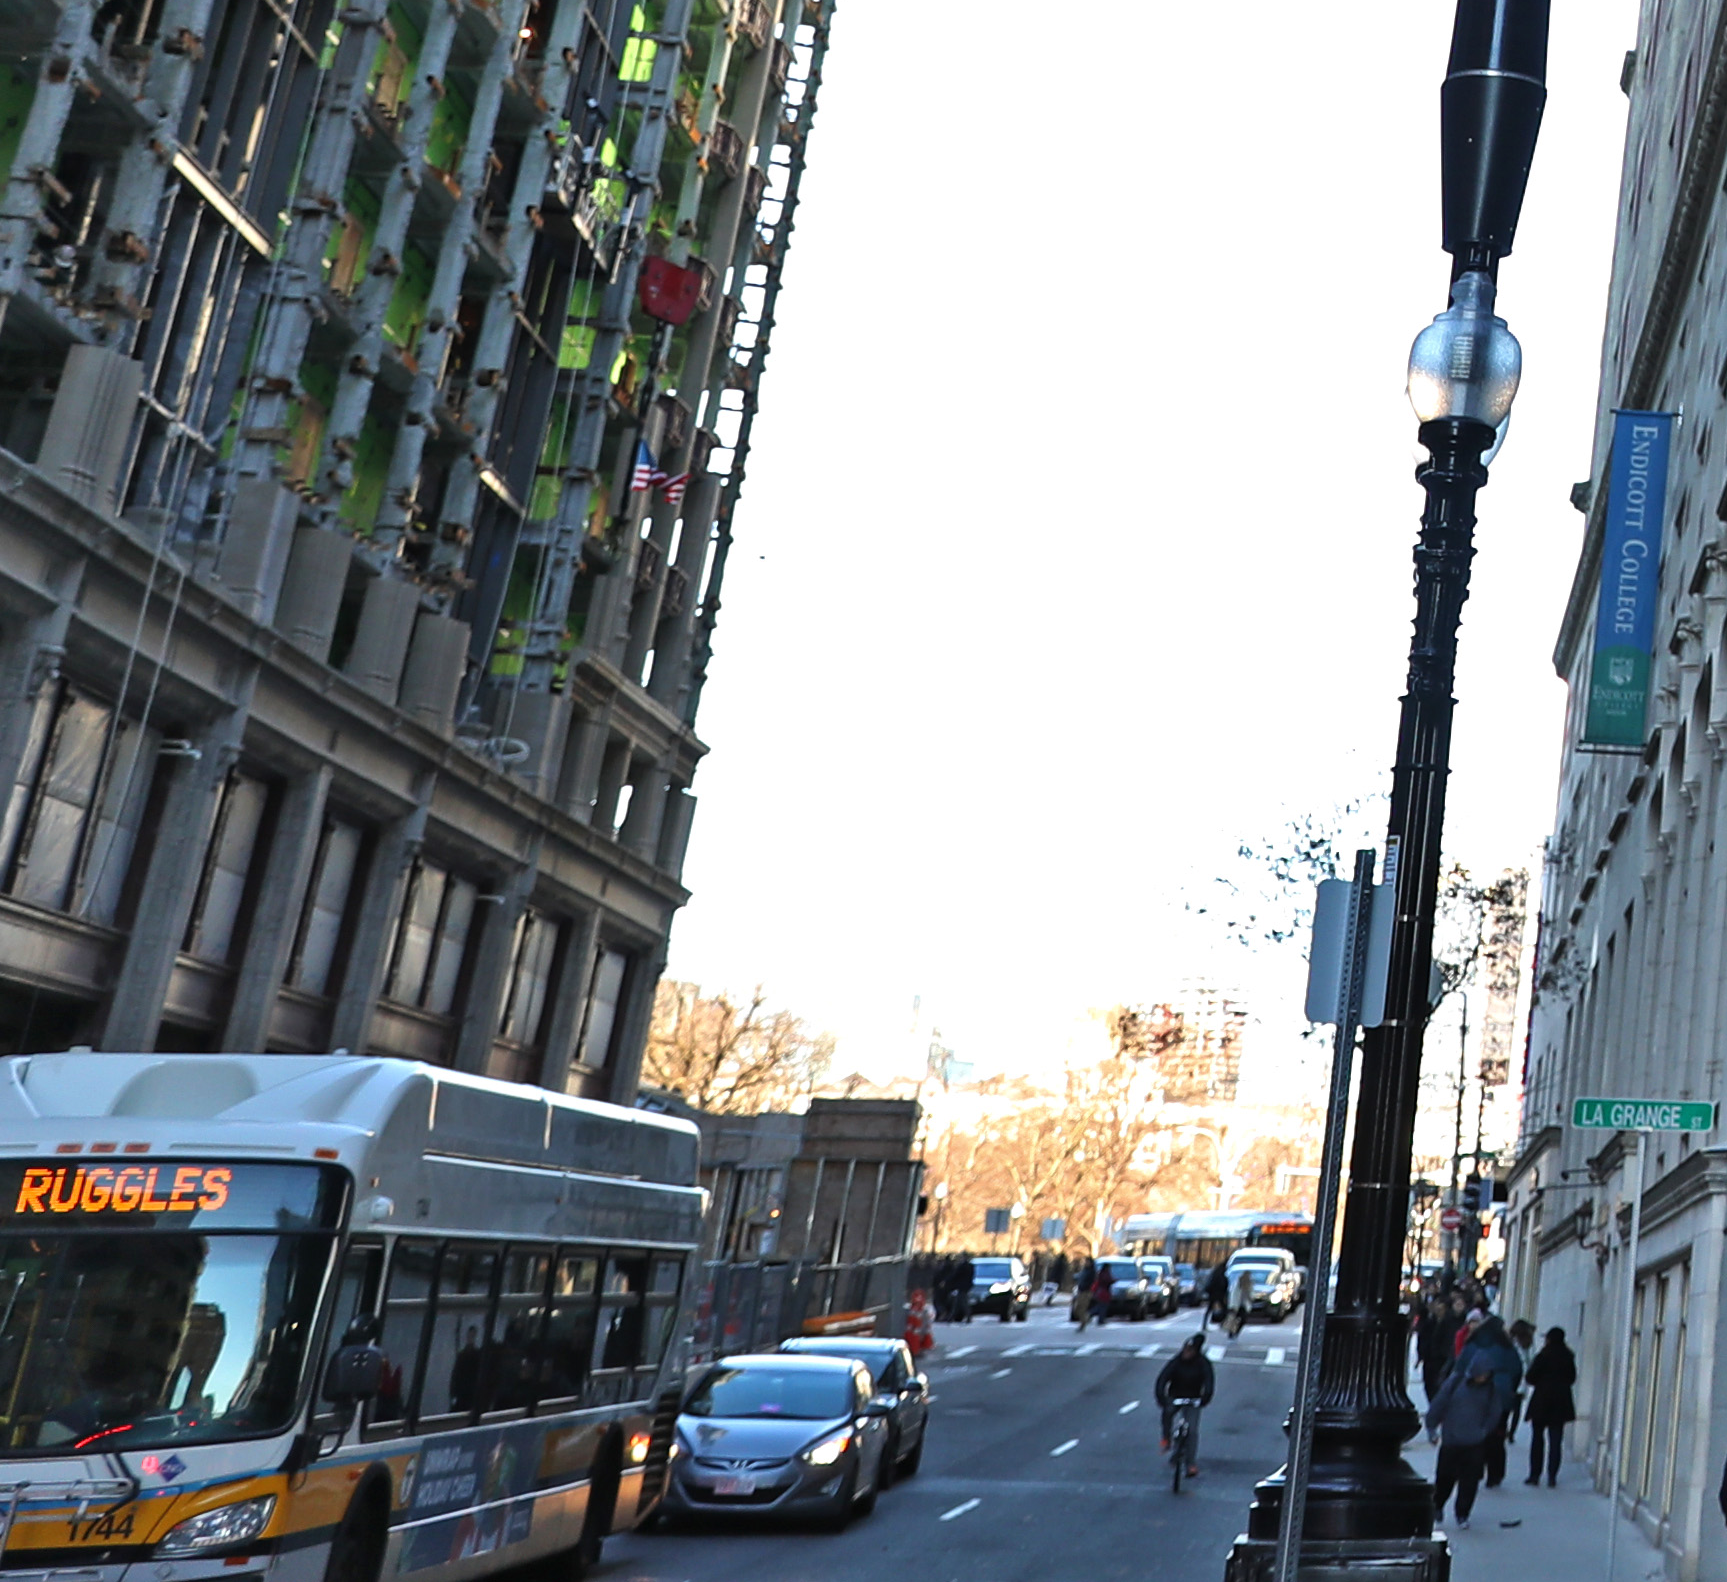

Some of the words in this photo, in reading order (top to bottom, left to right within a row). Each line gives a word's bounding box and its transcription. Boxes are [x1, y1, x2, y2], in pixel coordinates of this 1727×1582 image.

[1625, 424, 1658, 531] ENDICOTT
[1615, 540, 1648, 634] COLLEGE
[1581, 1103, 1603, 1126] LA
[1611, 1104, 1682, 1128] GRANGE
[1691, 1116, 1703, 1129] ST
[15, 1168, 232, 1213] RUGGLES
[68, 1514, 135, 1542] 1744
